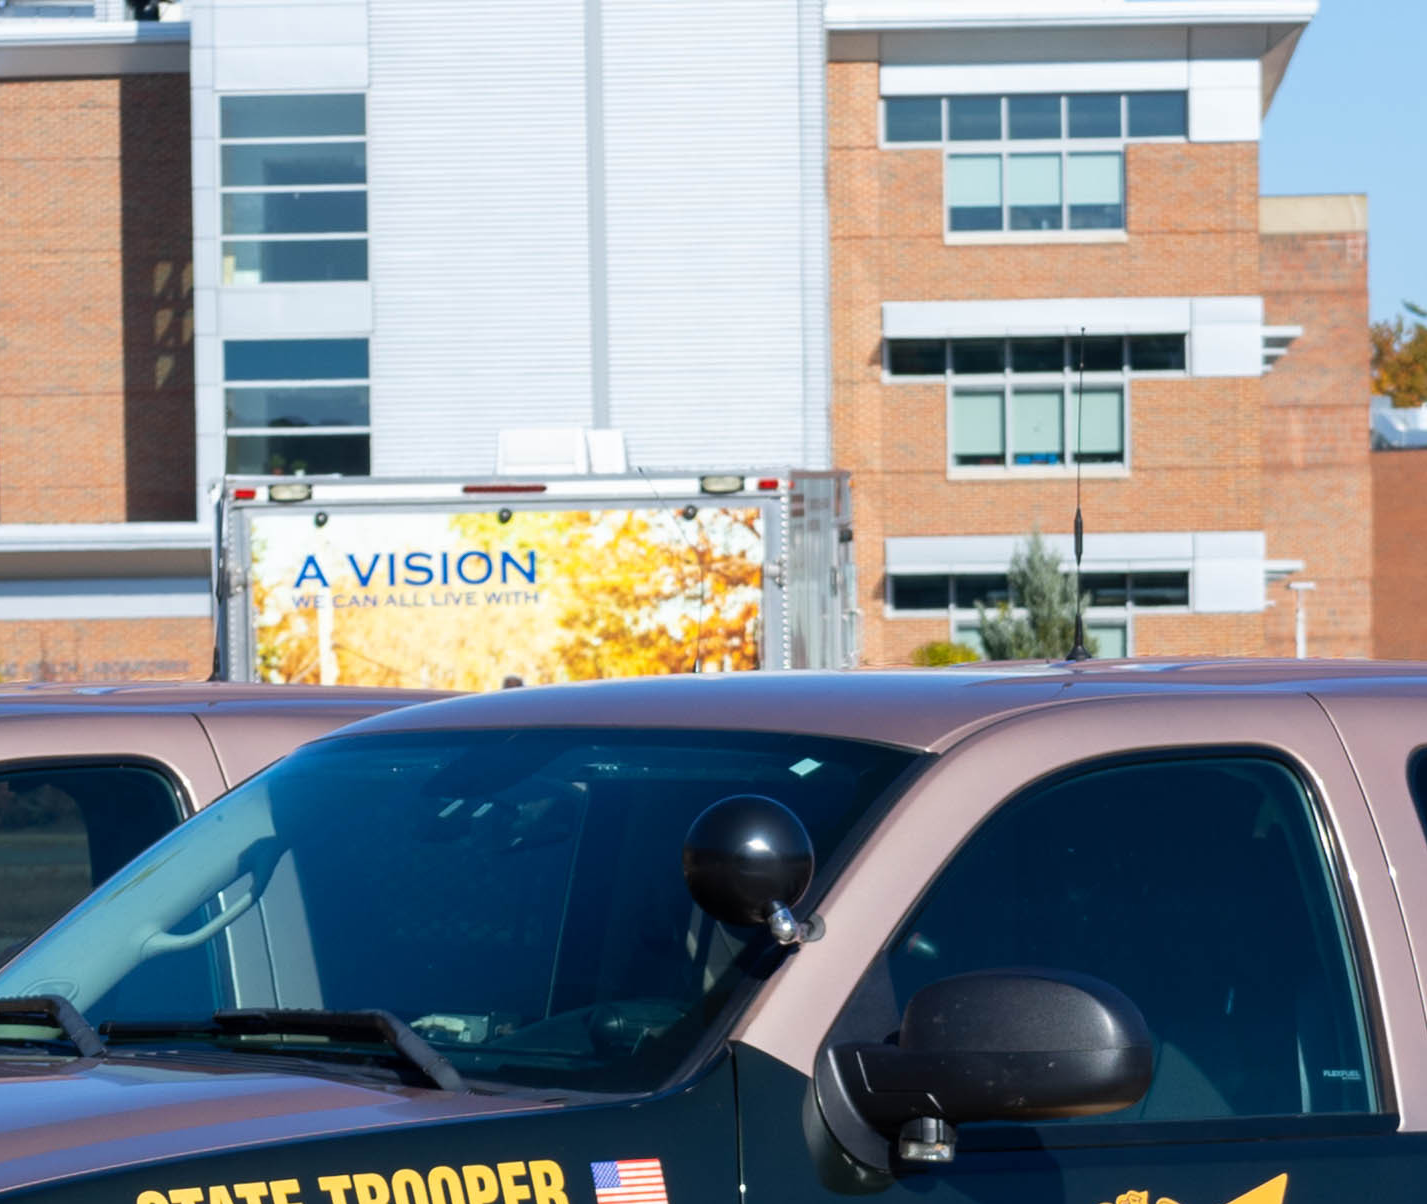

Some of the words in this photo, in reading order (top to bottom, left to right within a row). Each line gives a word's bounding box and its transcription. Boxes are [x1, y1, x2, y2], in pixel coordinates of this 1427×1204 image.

[293, 554, 330, 589] A
[347, 550, 537, 588] VISION
[291, 595, 325, 609] WE
[332, 594, 378, 609] CAN
[384, 593, 429, 607] ALL
[430, 592, 478, 607] LIVE
[484, 591, 540, 605] WITH
